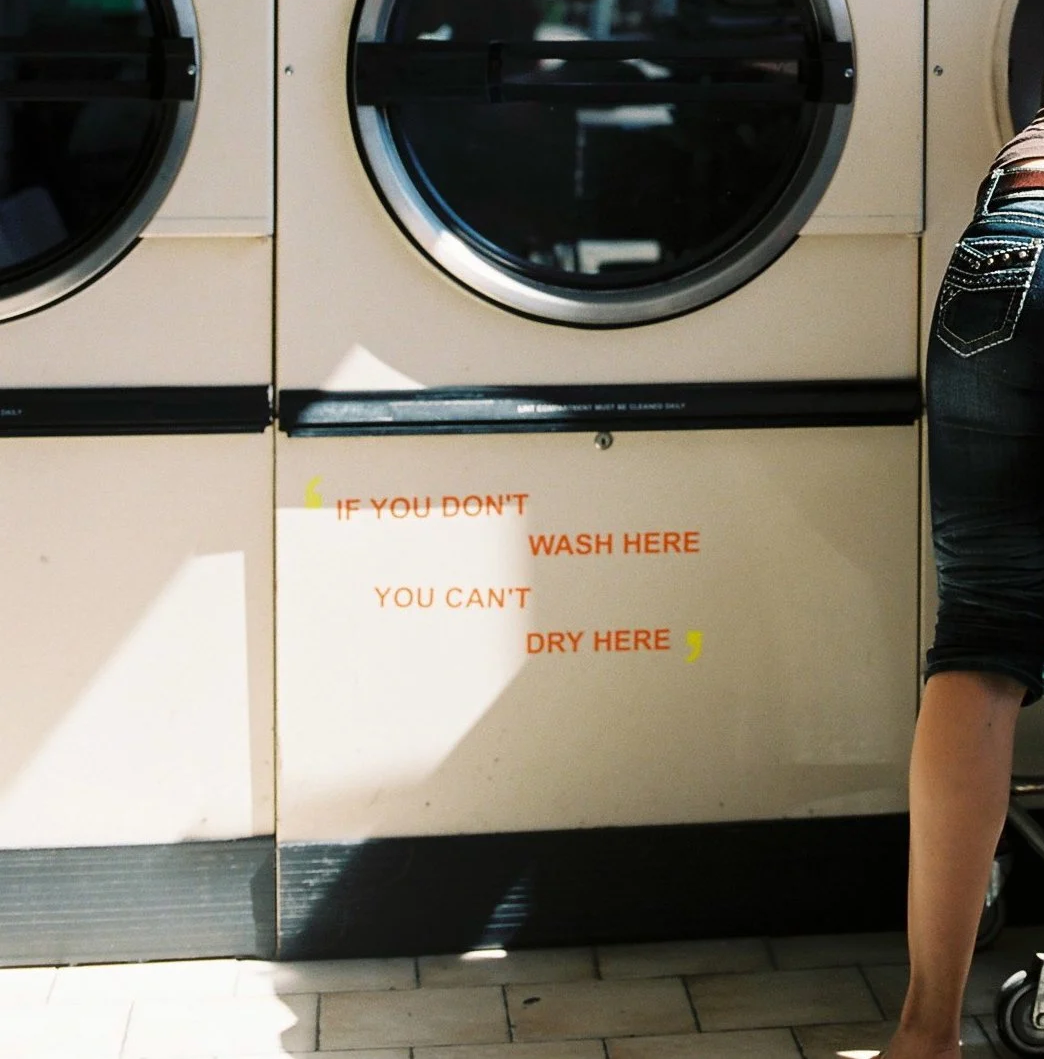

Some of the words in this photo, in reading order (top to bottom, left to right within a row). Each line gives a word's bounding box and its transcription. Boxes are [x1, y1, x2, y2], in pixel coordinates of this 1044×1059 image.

[336, 498, 361, 521] IF
[370, 495, 431, 519] YOU
[441, 493, 529, 518] DON'T
[528, 533, 614, 556] WASH
[623, 531, 700, 554] HERE
[374, 587, 434, 609] YOU
[445, 587, 531, 609] CAN'T
[526, 631, 584, 654] DRY
[593, 629, 671, 652] HERE
